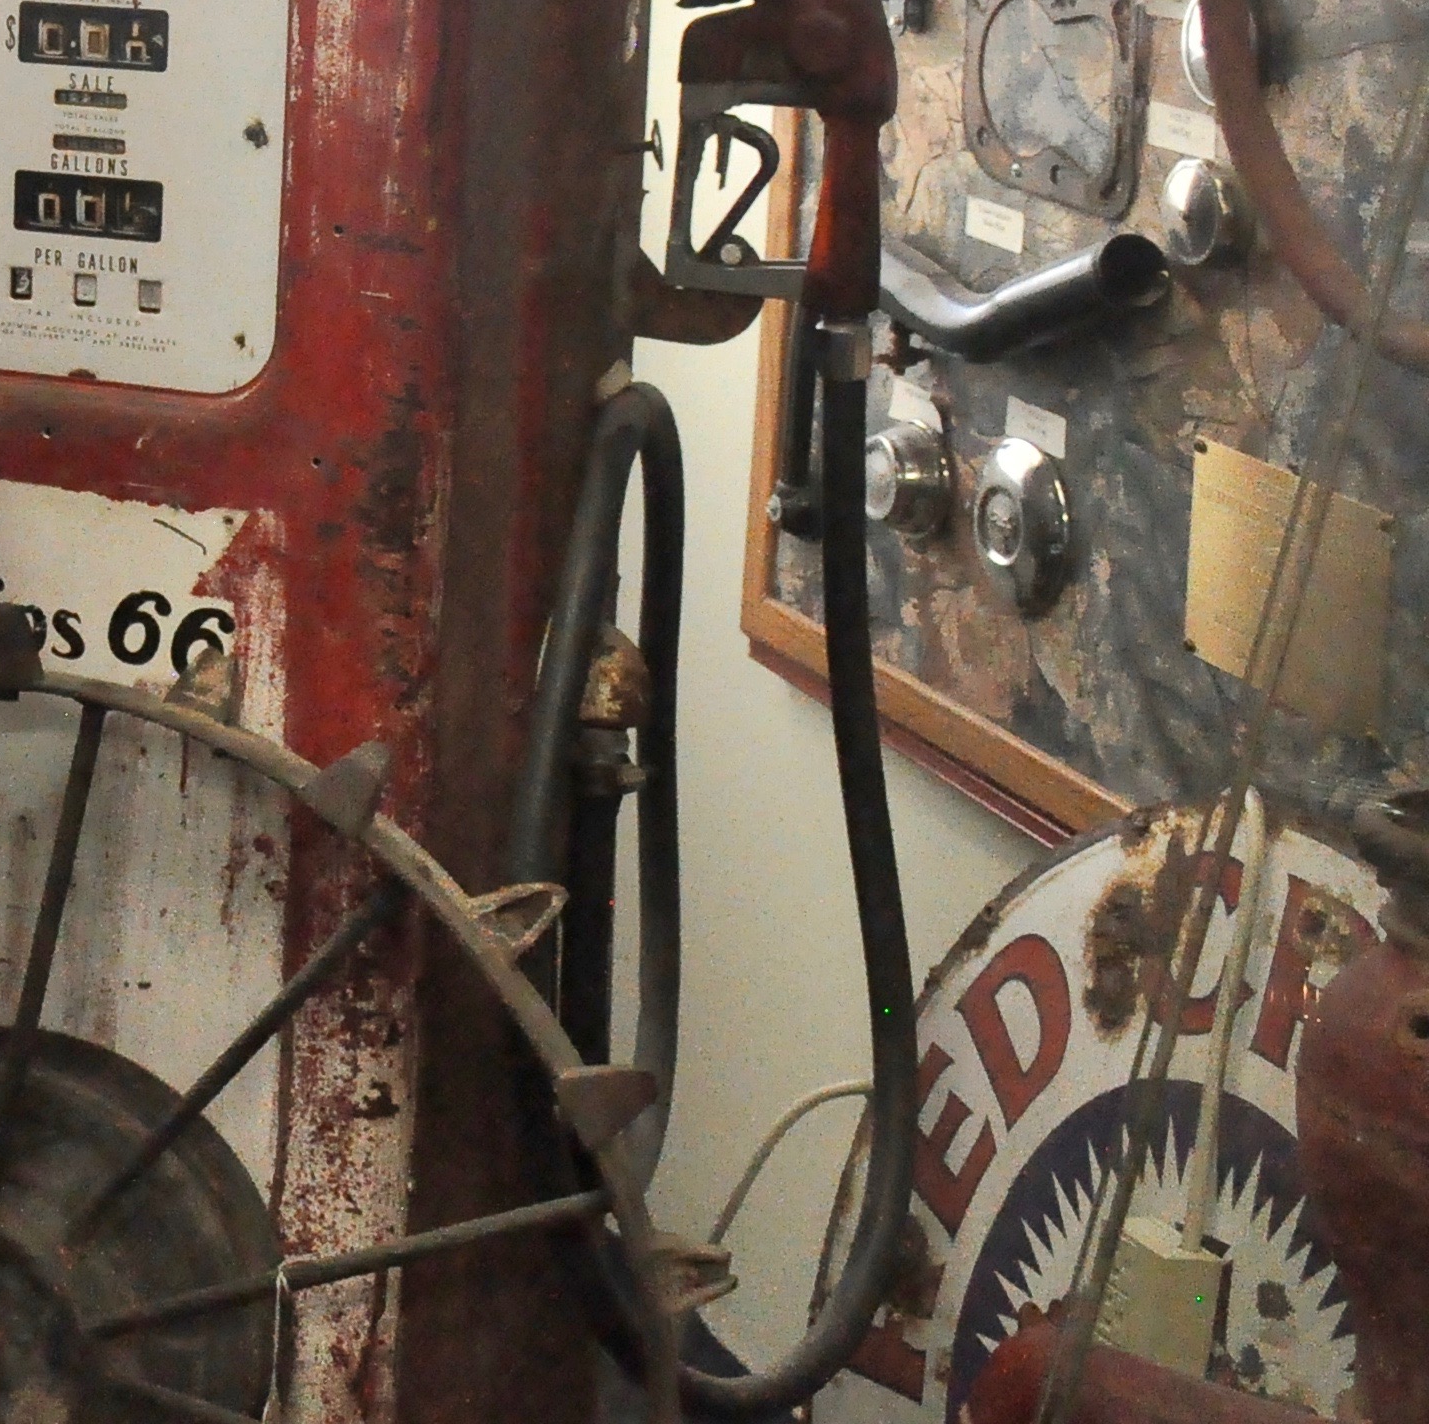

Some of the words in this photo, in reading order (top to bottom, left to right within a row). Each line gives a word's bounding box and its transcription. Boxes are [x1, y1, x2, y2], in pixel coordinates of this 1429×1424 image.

[68, 72, 115, 93] SALE
[50, 153, 129, 176] GALLONS
[34, 247, 63, 266] PER
[77, 252, 139, 274] GALLON
[106, 590, 236, 677] 66
